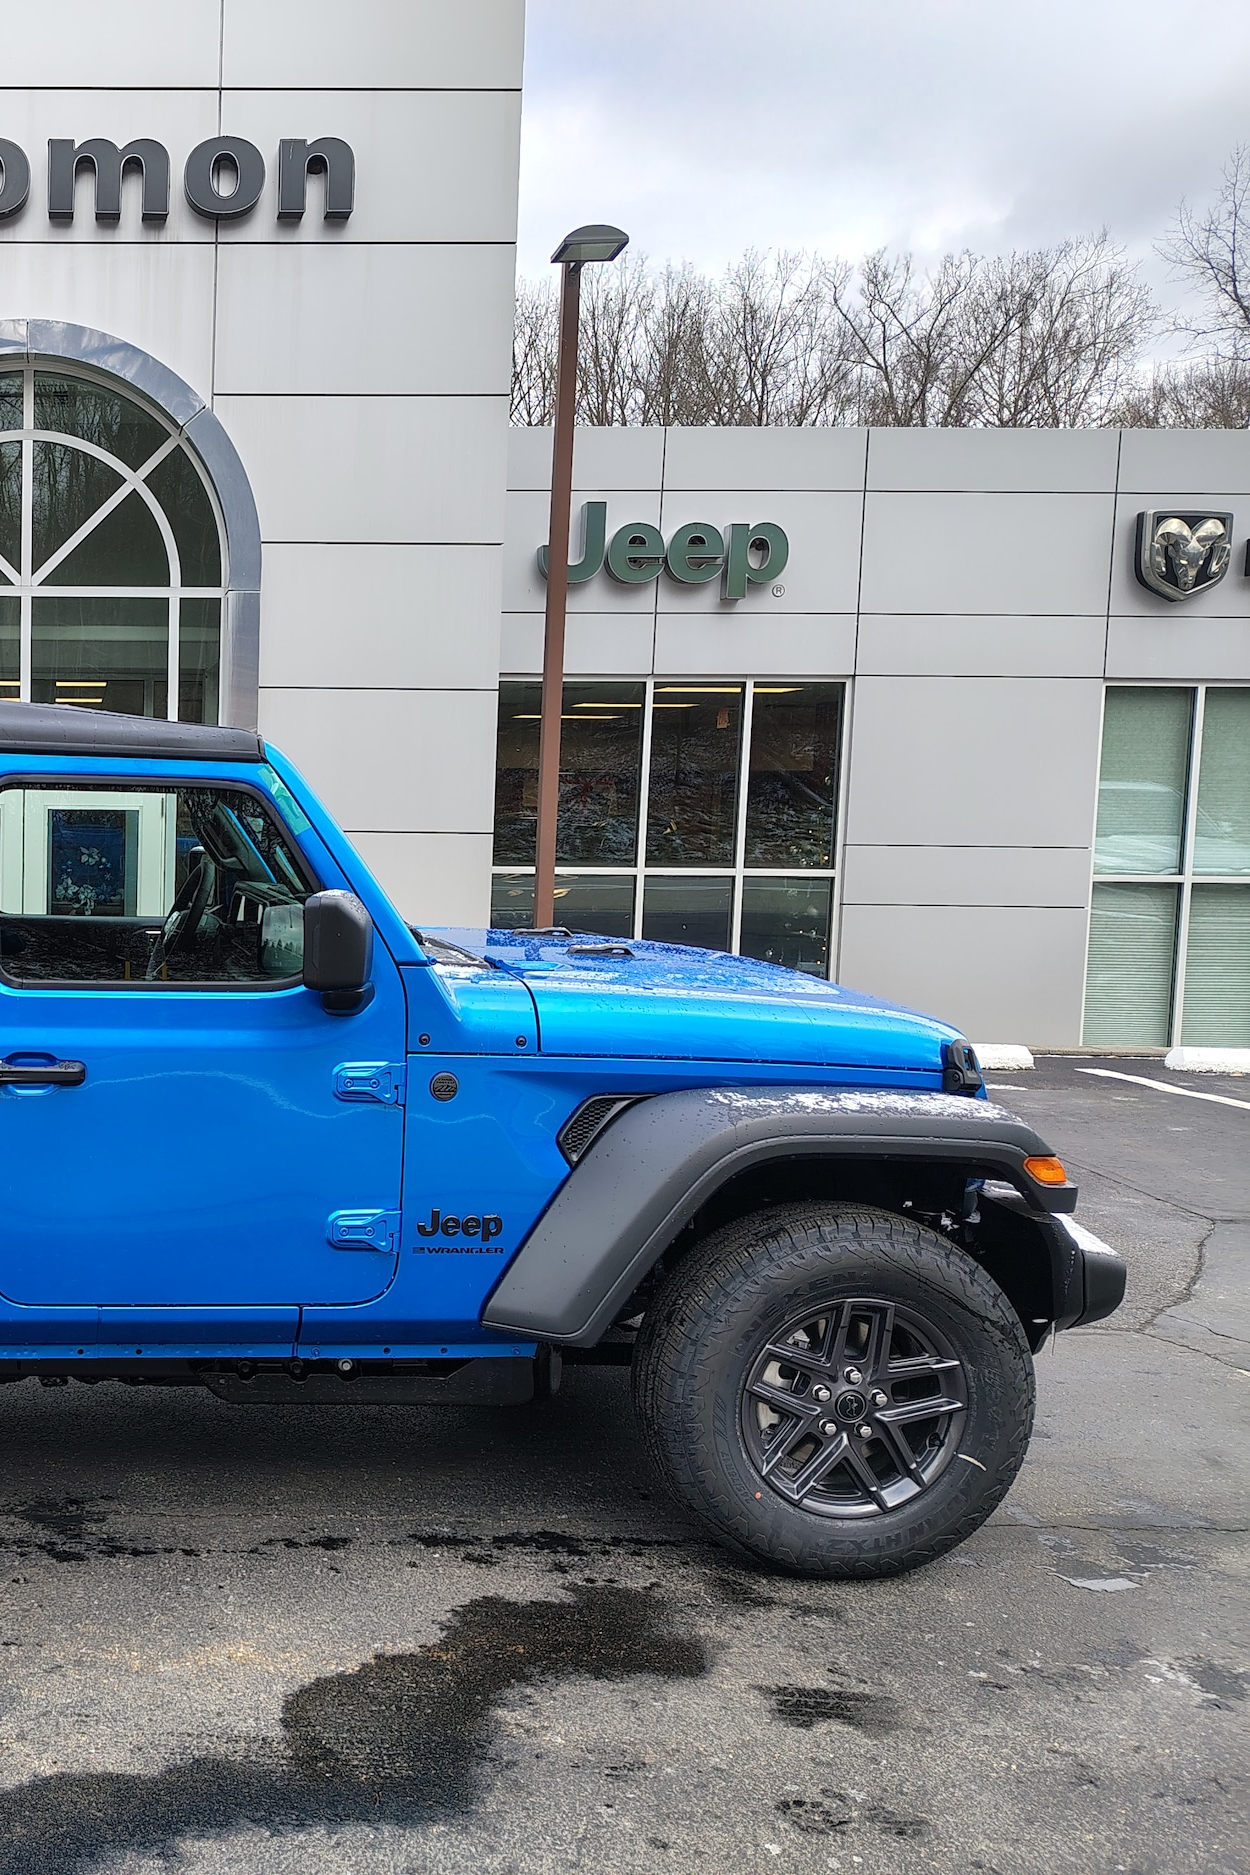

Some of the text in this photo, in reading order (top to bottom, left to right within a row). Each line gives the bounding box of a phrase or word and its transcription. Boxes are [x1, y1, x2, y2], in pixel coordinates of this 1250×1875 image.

[537, 500, 790, 600] Jeep
[417, 1208, 503, 1242] Jeep
[739, 1272, 857, 1343] NEXEN
